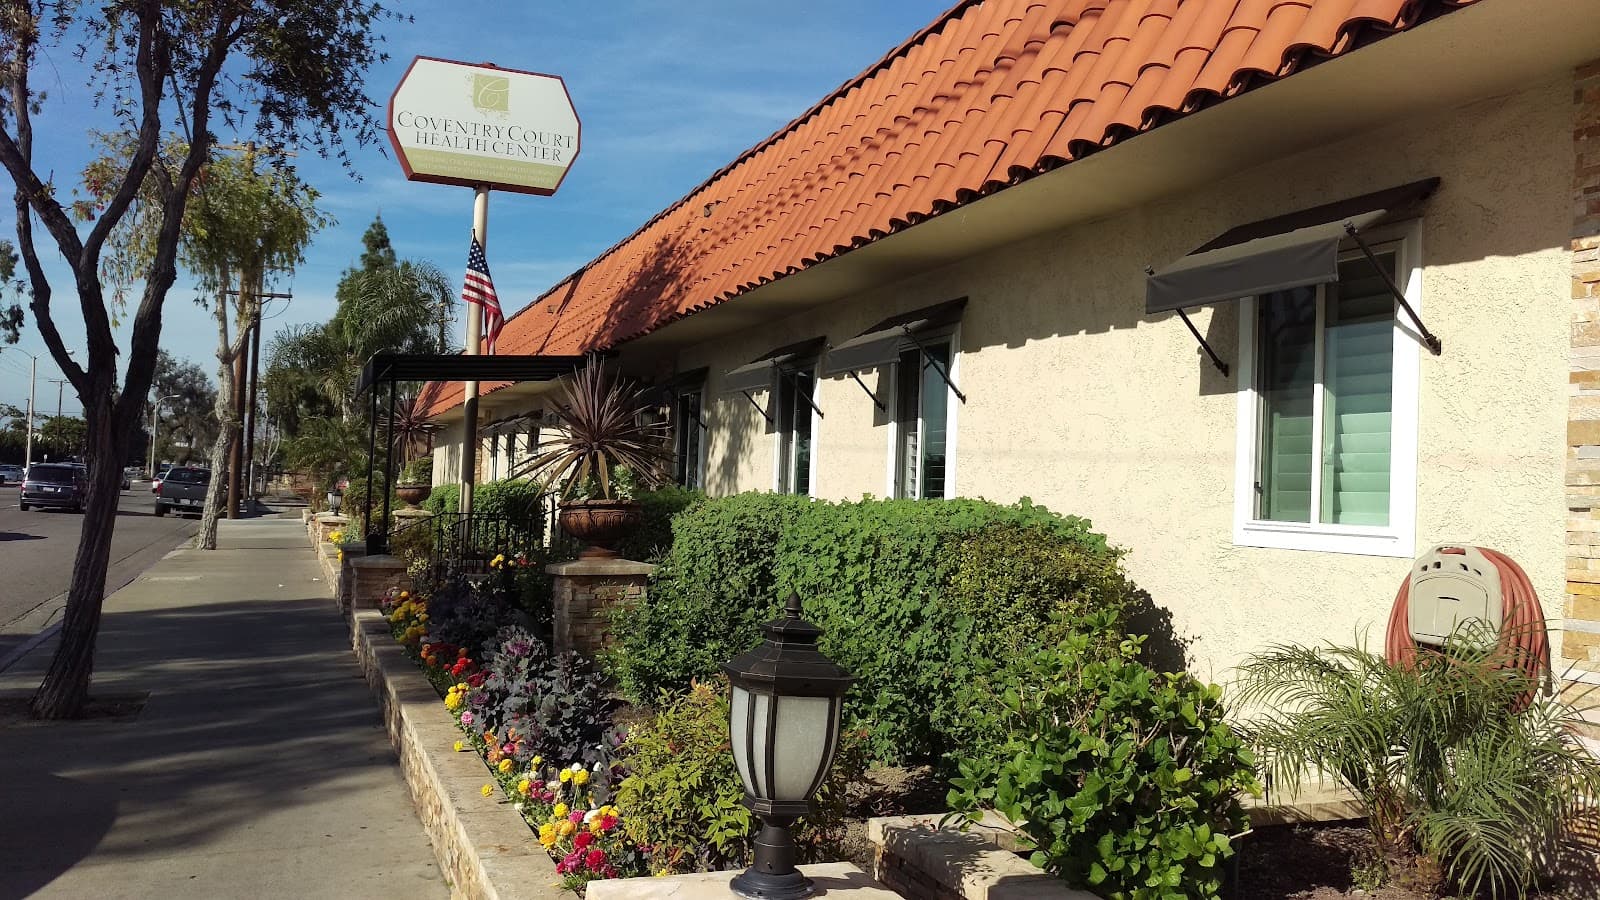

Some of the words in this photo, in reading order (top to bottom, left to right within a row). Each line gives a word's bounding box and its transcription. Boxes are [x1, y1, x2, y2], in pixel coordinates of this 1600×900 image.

[397, 110, 504, 139] COVENTRY
[508, 125, 573, 149] COURT
[416, 131, 488, 152] HEALTH
[492, 141, 561, 162] CENTER
